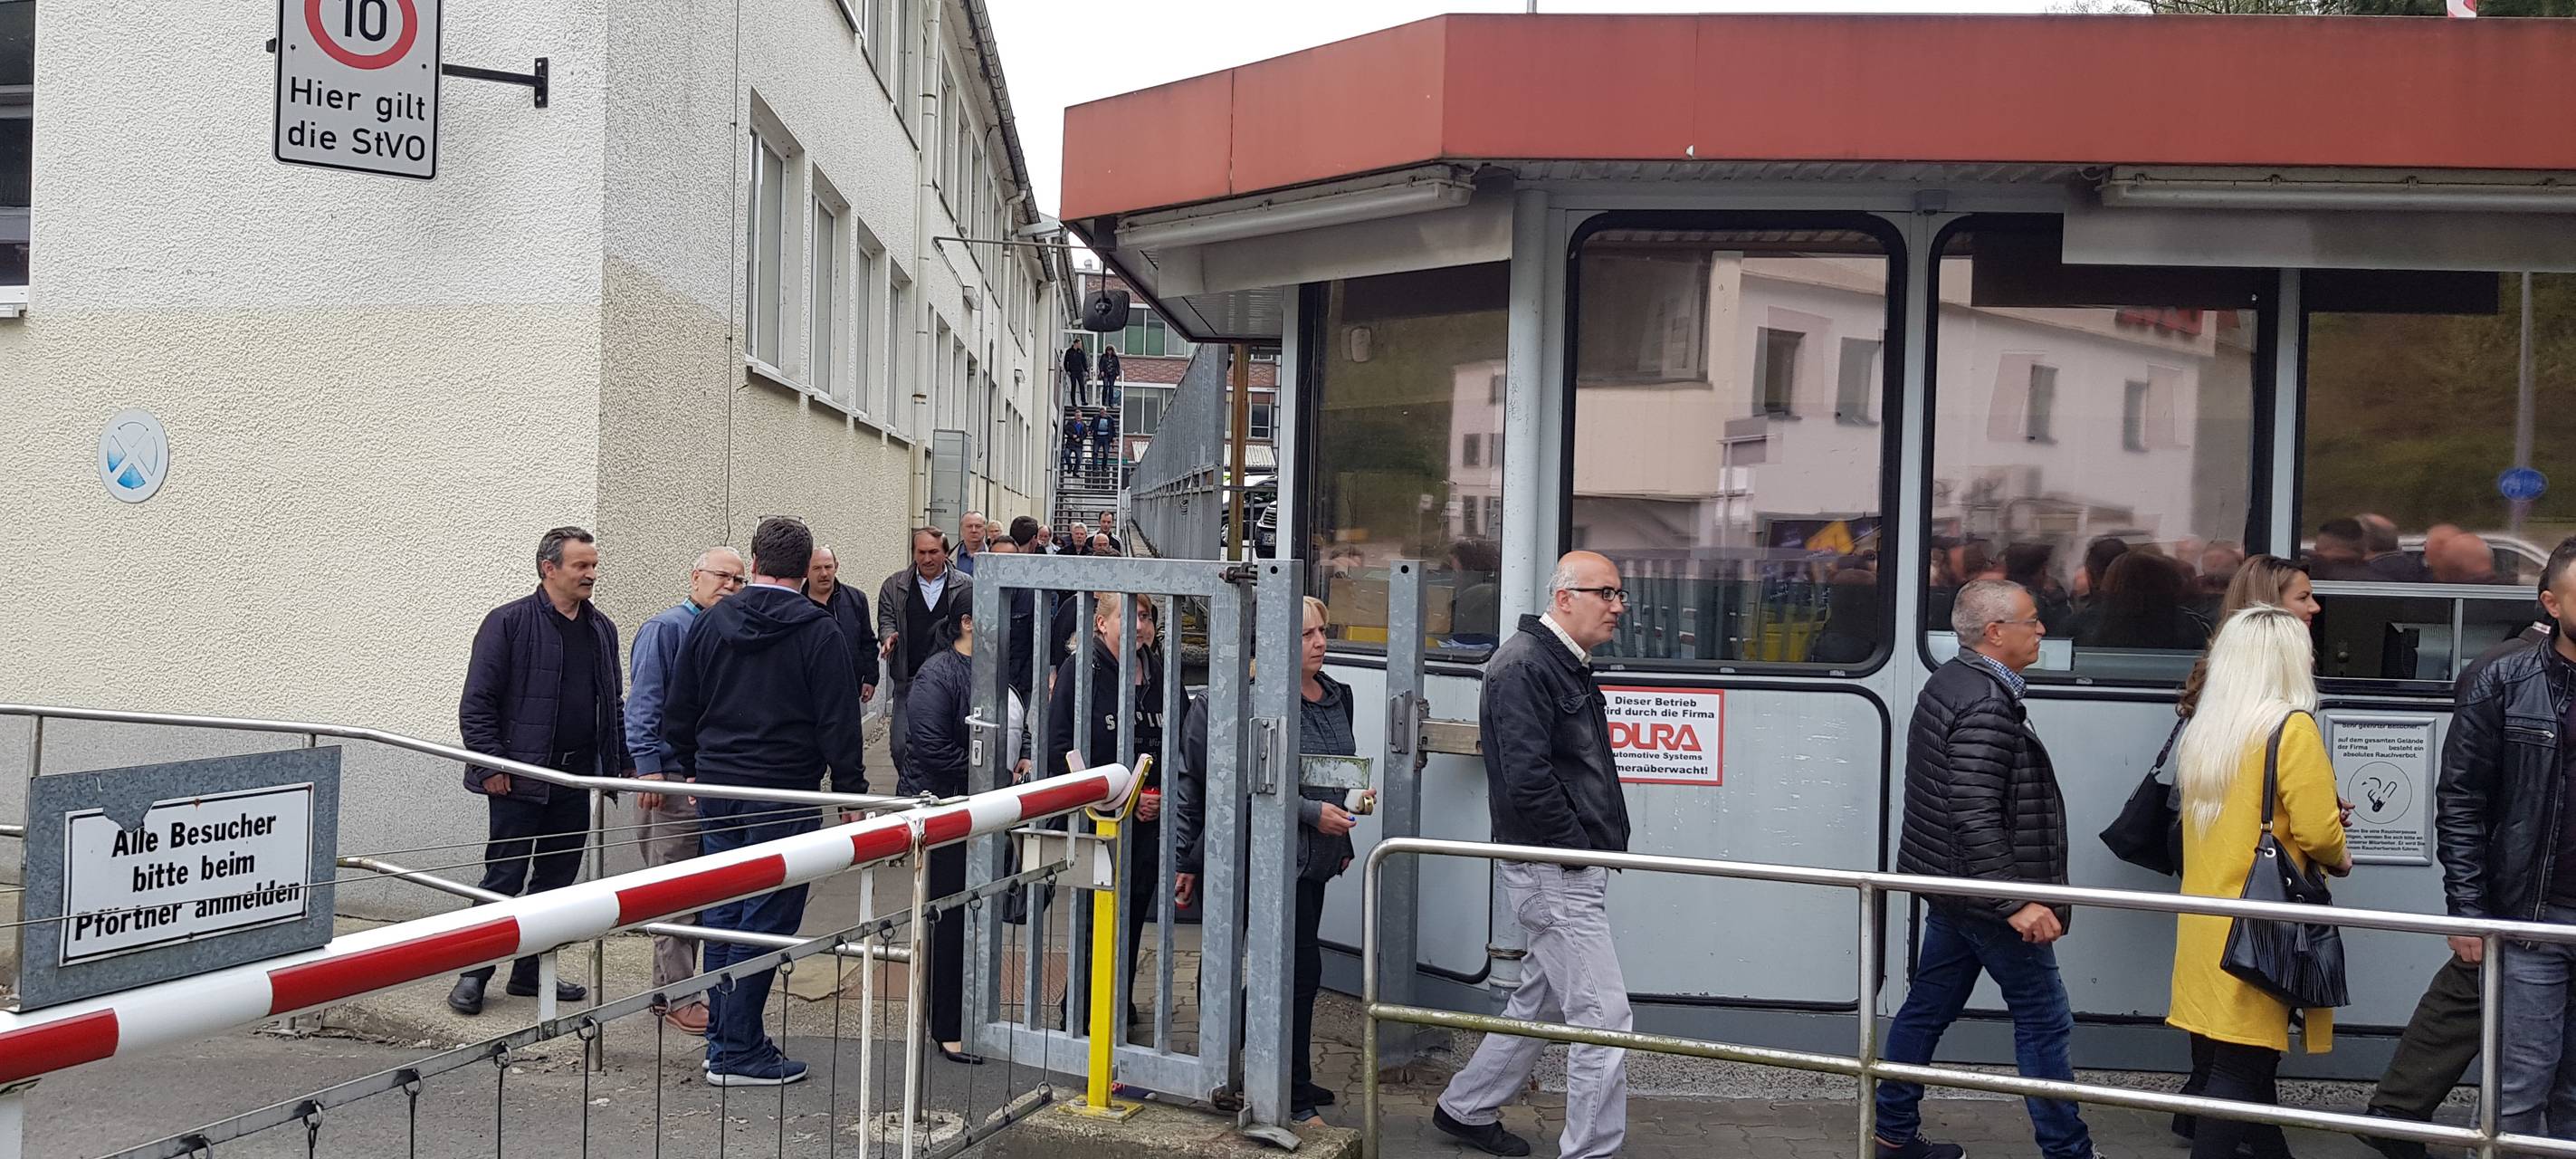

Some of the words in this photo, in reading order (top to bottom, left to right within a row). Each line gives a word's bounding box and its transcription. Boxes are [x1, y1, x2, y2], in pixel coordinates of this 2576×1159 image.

[339, 0, 387, 41] 10
[291, 77, 361, 111] Hier
[377, 92, 425, 123] gilt
[288, 120, 337, 150] die
[352, 128, 425, 161] StVO
[1615, 696, 1651, 705] Dieser
[1655, 698, 1697, 707] Betrieb
[1625, 708, 1657, 716] durch
[1661, 709, 1678, 717] die
[1683, 709, 1714, 718] Firma
[1608, 722, 1702, 752] DURA
[1614, 752, 1660, 760] utomotive
[1663, 752, 1703, 761] Systems
[1616, 763, 1708, 775] meraüberwacht!
[111, 826, 158, 857] Alle
[170, 813, 276, 848] Besucher
[133, 863, 188, 893] bitte
[201, 853, 254, 881] beim
[74, 903, 182, 941] Pförtner
[195, 880, 301, 918] anmelden
